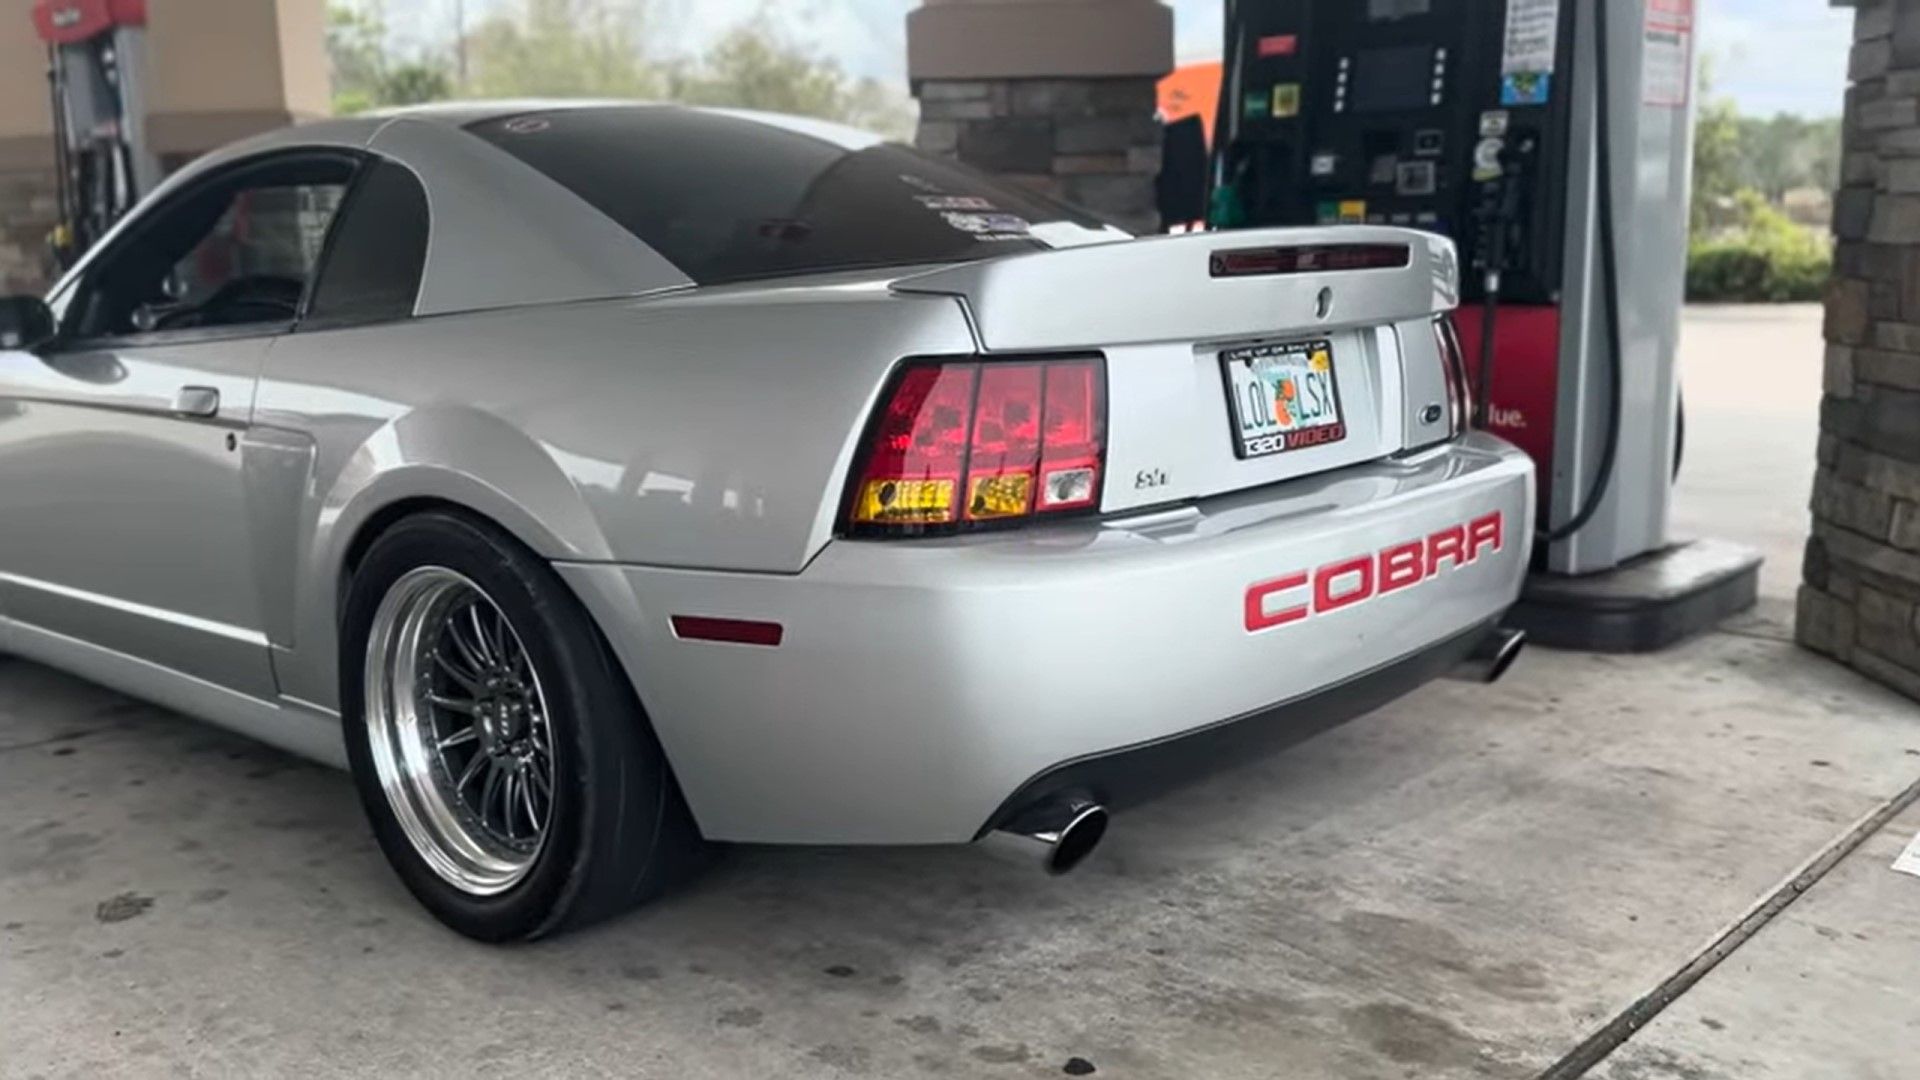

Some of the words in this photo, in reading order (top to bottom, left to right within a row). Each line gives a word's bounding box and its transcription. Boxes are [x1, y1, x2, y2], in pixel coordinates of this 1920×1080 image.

[1235, 380, 1277, 430] LOL
[1294, 371, 1333, 420] LSX
[1286, 423, 1344, 449] VIDEO
[1244, 510, 1503, 633] COBRA
